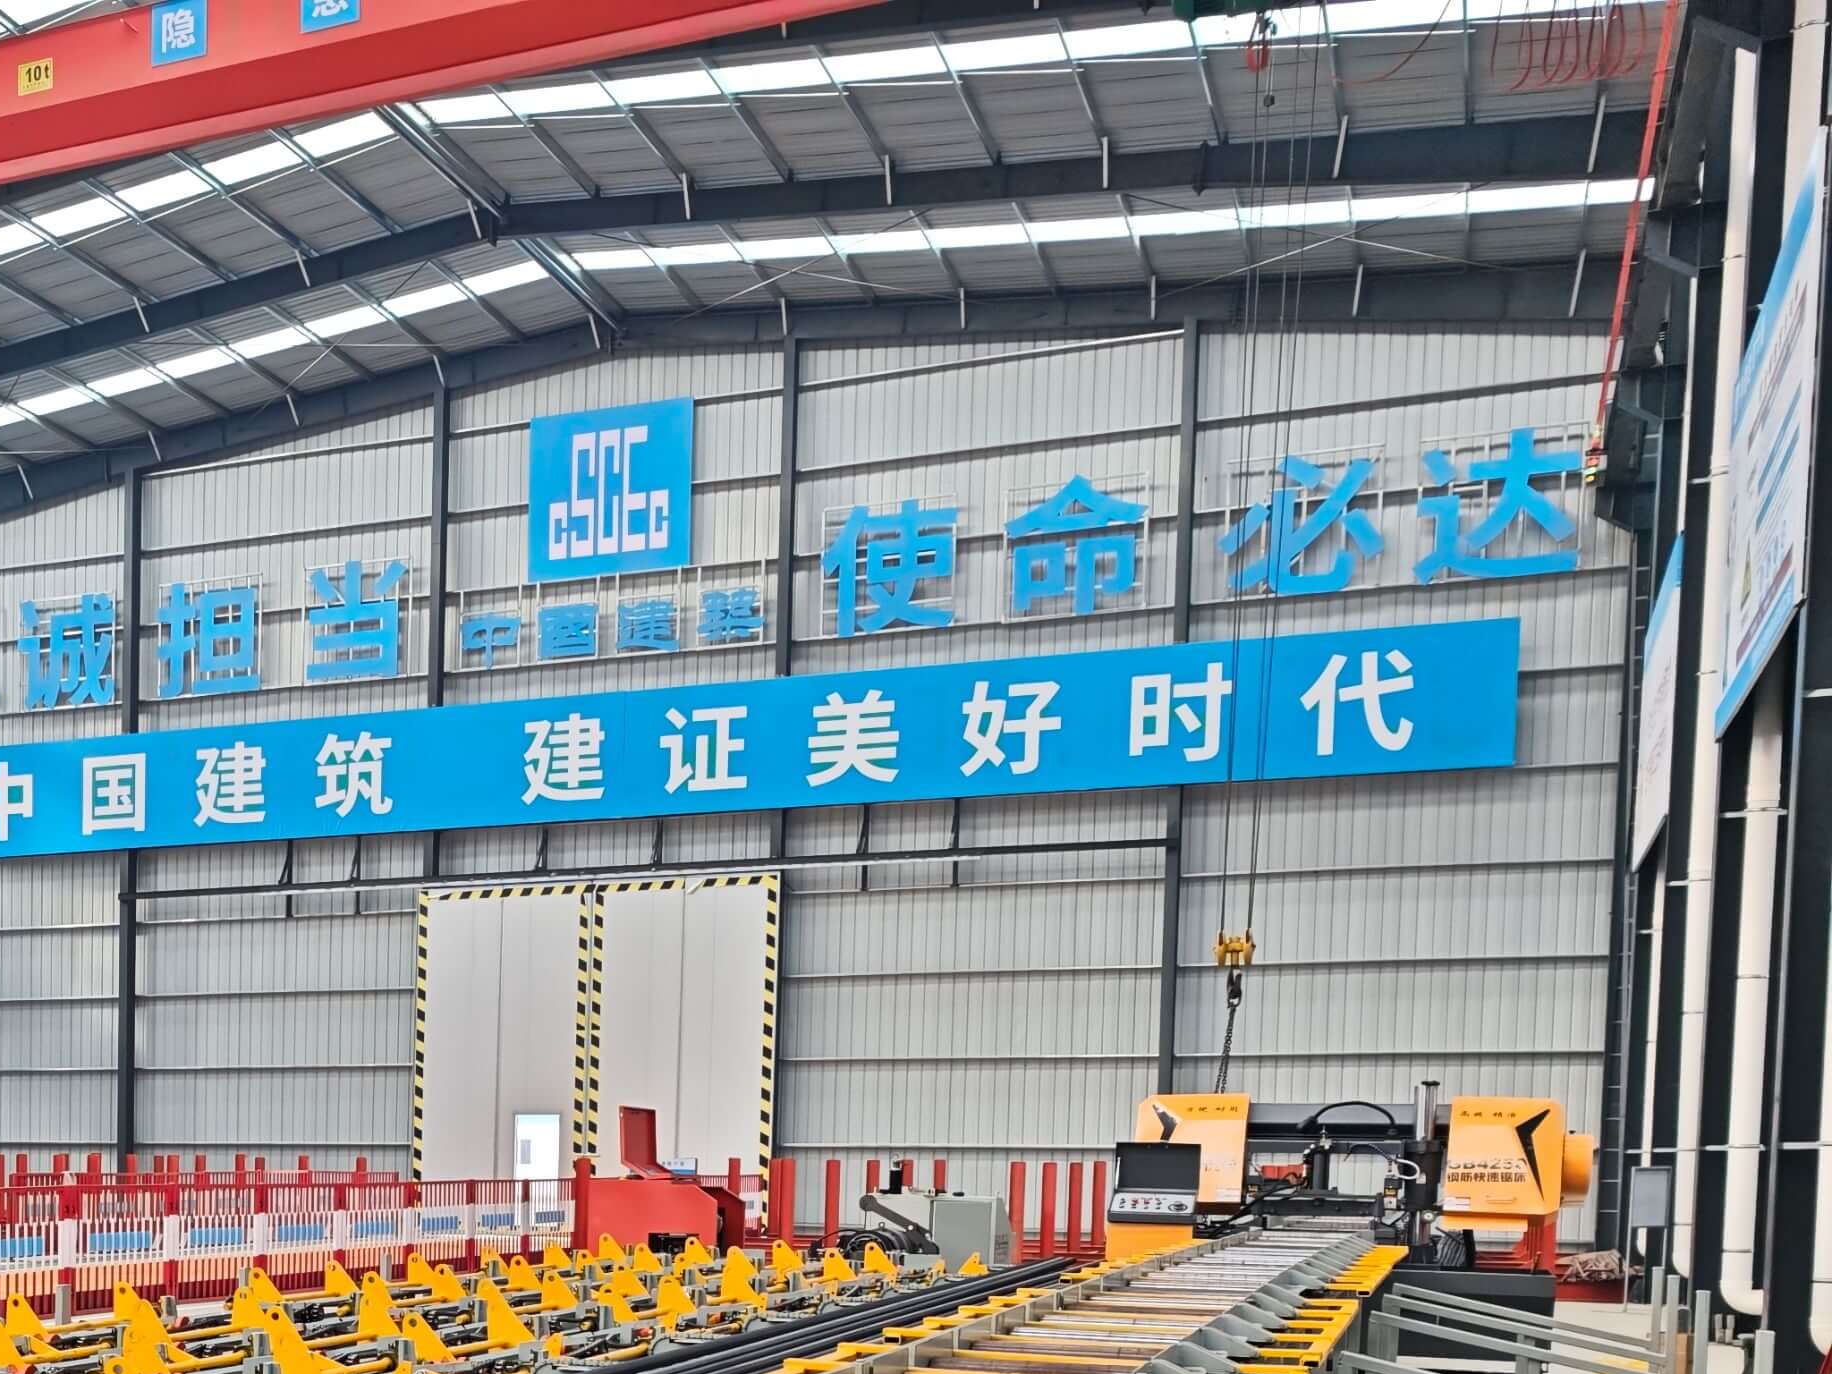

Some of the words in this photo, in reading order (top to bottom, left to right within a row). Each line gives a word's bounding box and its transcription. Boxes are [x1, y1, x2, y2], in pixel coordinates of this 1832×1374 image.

[161, 8, 195, 54] 隐
[821, 427, 1582, 639] 使命必达
[522, 649, 1416, 806] 建证美好时代
